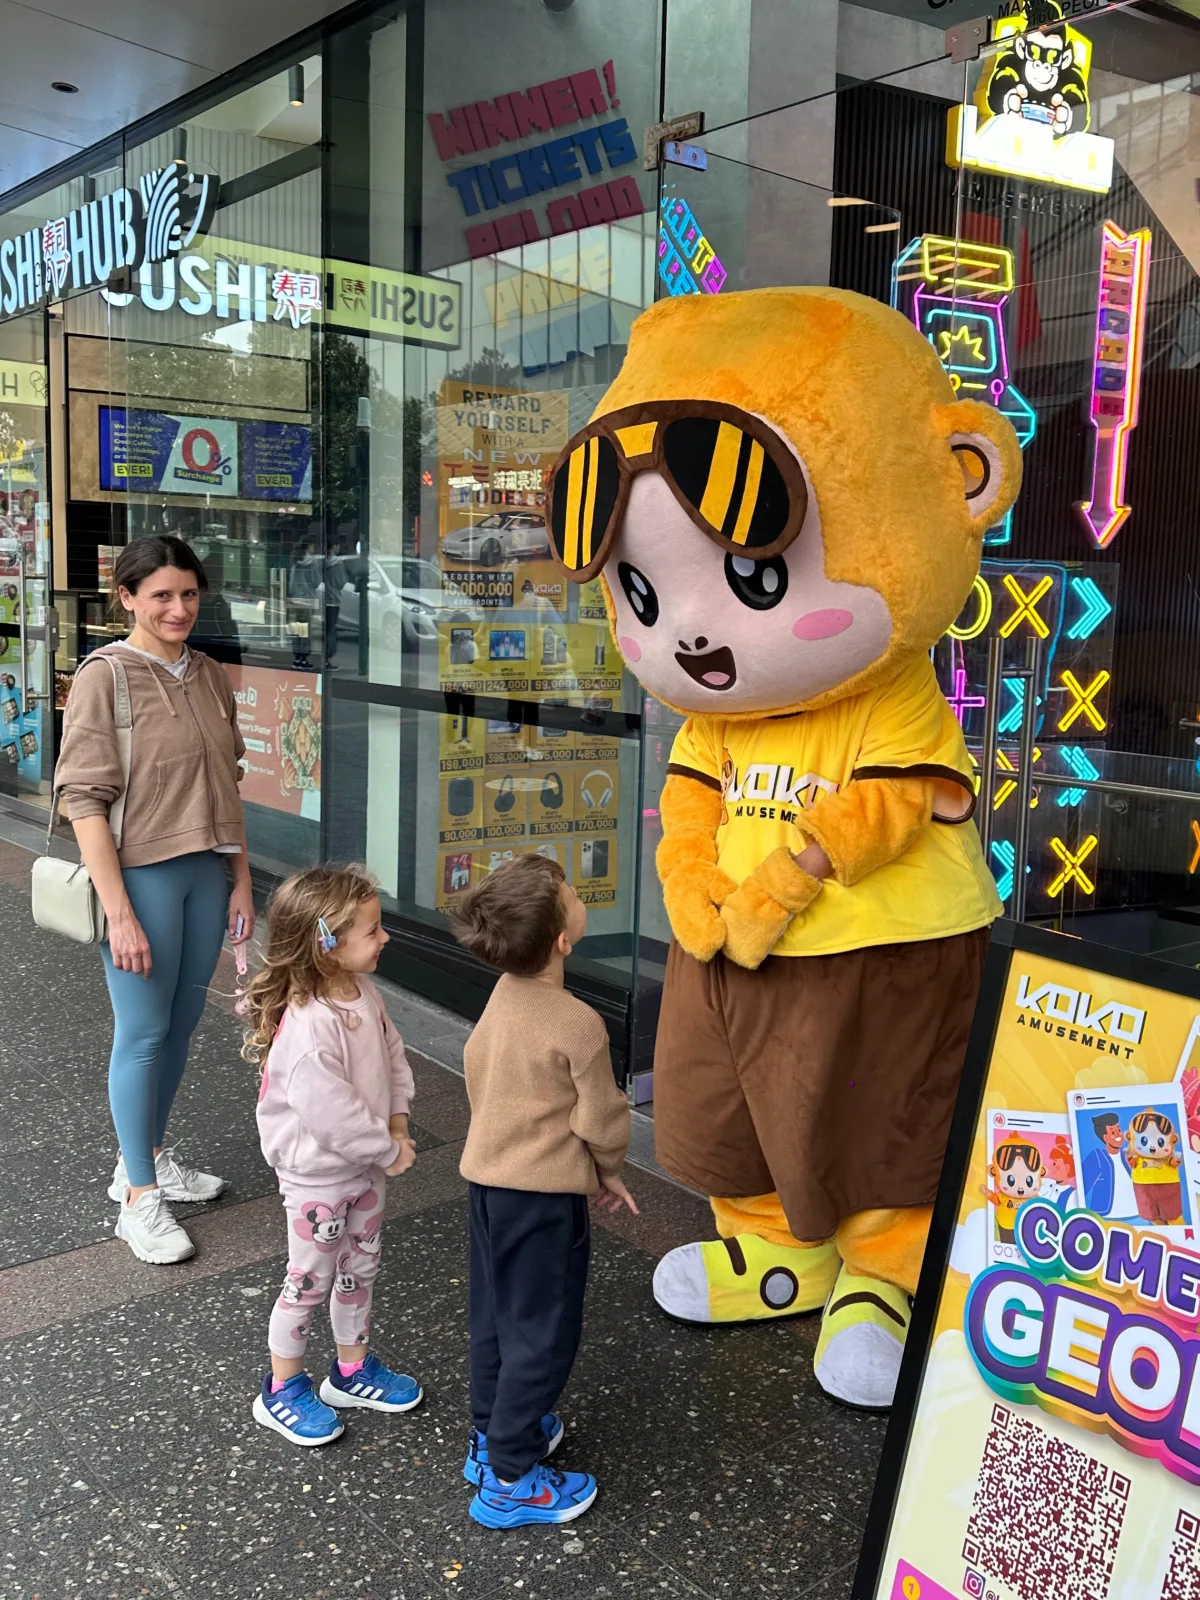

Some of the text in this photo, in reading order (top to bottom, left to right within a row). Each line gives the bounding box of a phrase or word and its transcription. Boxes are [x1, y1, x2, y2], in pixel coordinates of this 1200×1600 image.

[428, 59, 621, 161] WINNER!
[446, 117, 639, 217] TICKETS
[0, 186, 137, 314] SHI HUB
[463, 389, 541, 413] REWARD
[454, 409, 551, 434] YOURSELF
[482, 434, 511, 448] WITH
[463, 447, 542, 466] NEW
[116, 465, 151, 475] EVER!
[176, 469, 221, 483] Surcharge
[257, 475, 291, 485] EVER!
[443, 581, 513, 597] 10,000,000
[475, 598, 503, 606] POINTS
[486, 680, 528, 691] 242,000
[535, 680, 572, 690] 99,000
[578, 680, 620, 690] 264,000
[487, 752, 525, 763] 396,000
[577, 749, 617, 759] 485,000
[441, 758, 482, 771] 198,000
[735, 806, 798, 825] MUSEME
[487, 825, 522, 837] 100,000
[534, 822, 569, 833] 115,000
[578, 819, 615, 831] 170,000
[444, 829, 477, 841] 90,000
[1015, 975, 1148, 1044] KOKO
[1016, 1013, 1135, 1060] AMUSEMENT
[1020, 1204, 1200, 1317] COME
